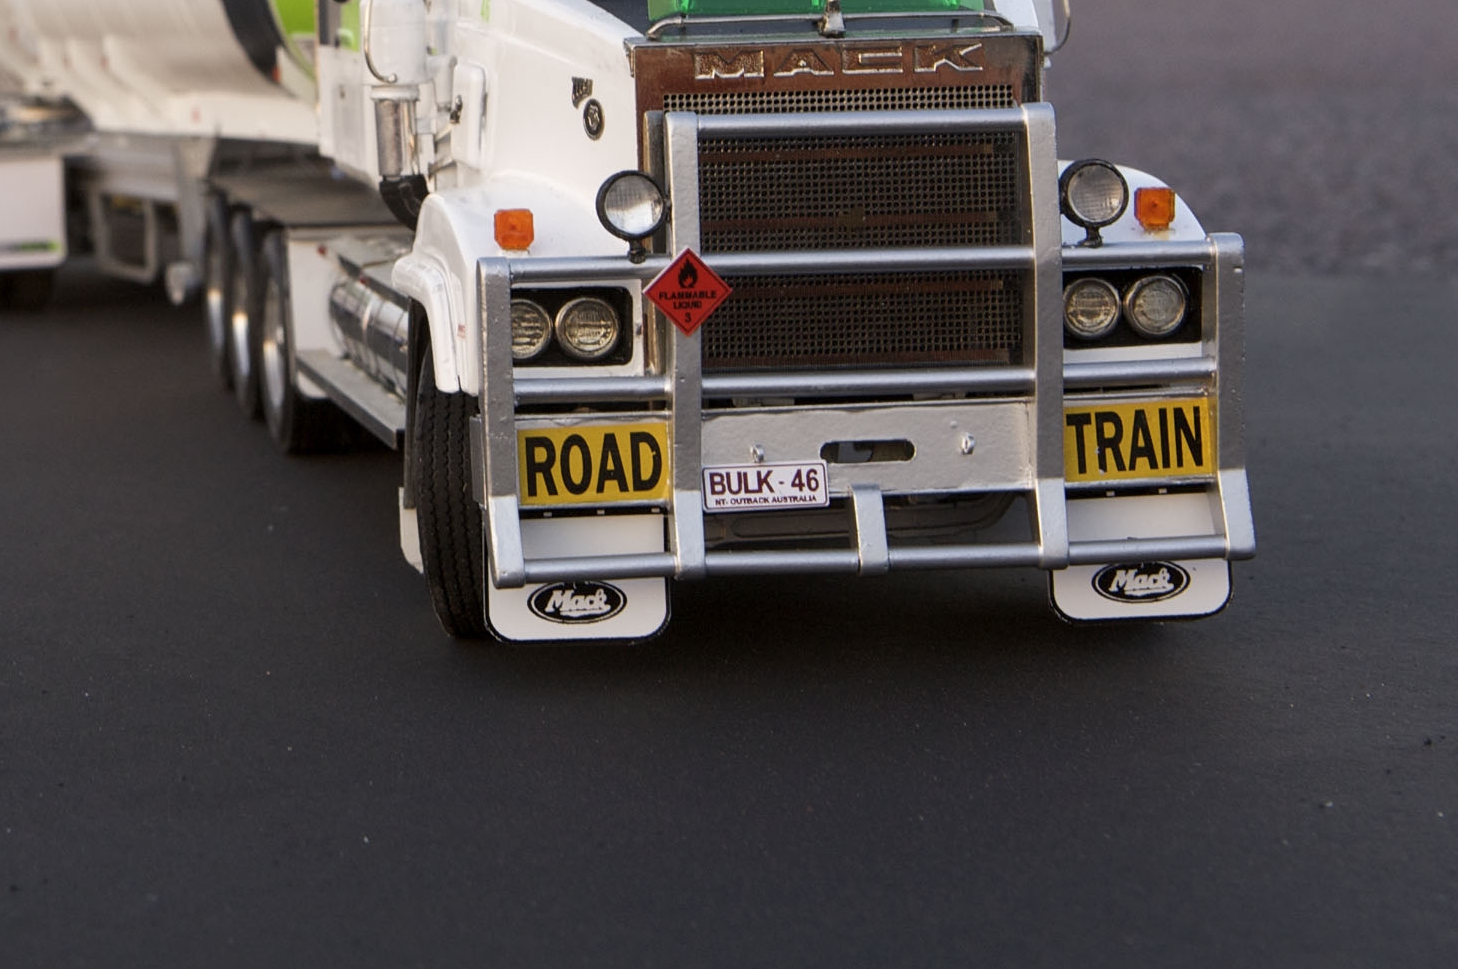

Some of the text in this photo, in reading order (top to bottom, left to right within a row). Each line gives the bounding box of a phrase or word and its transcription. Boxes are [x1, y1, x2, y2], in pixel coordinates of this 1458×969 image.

[694, 43, 983, 80] MACK
[658, 290, 717, 301] FLAMMABLE
[673, 300, 703, 310] LIQUID
[684, 312, 692, 324] 3
[1065, 406, 1204, 475] TRAIN
[525, 431, 663, 498] ROAD
[709, 470, 775, 496] BULK
[791, 468, 820, 492] 46
[730, 496, 770, 505] OUTBACK
[771, 495, 817, 504] AUSTRALIA
[1108, 567, 1175, 598] Mack
[544, 587, 612, 618] Mack
